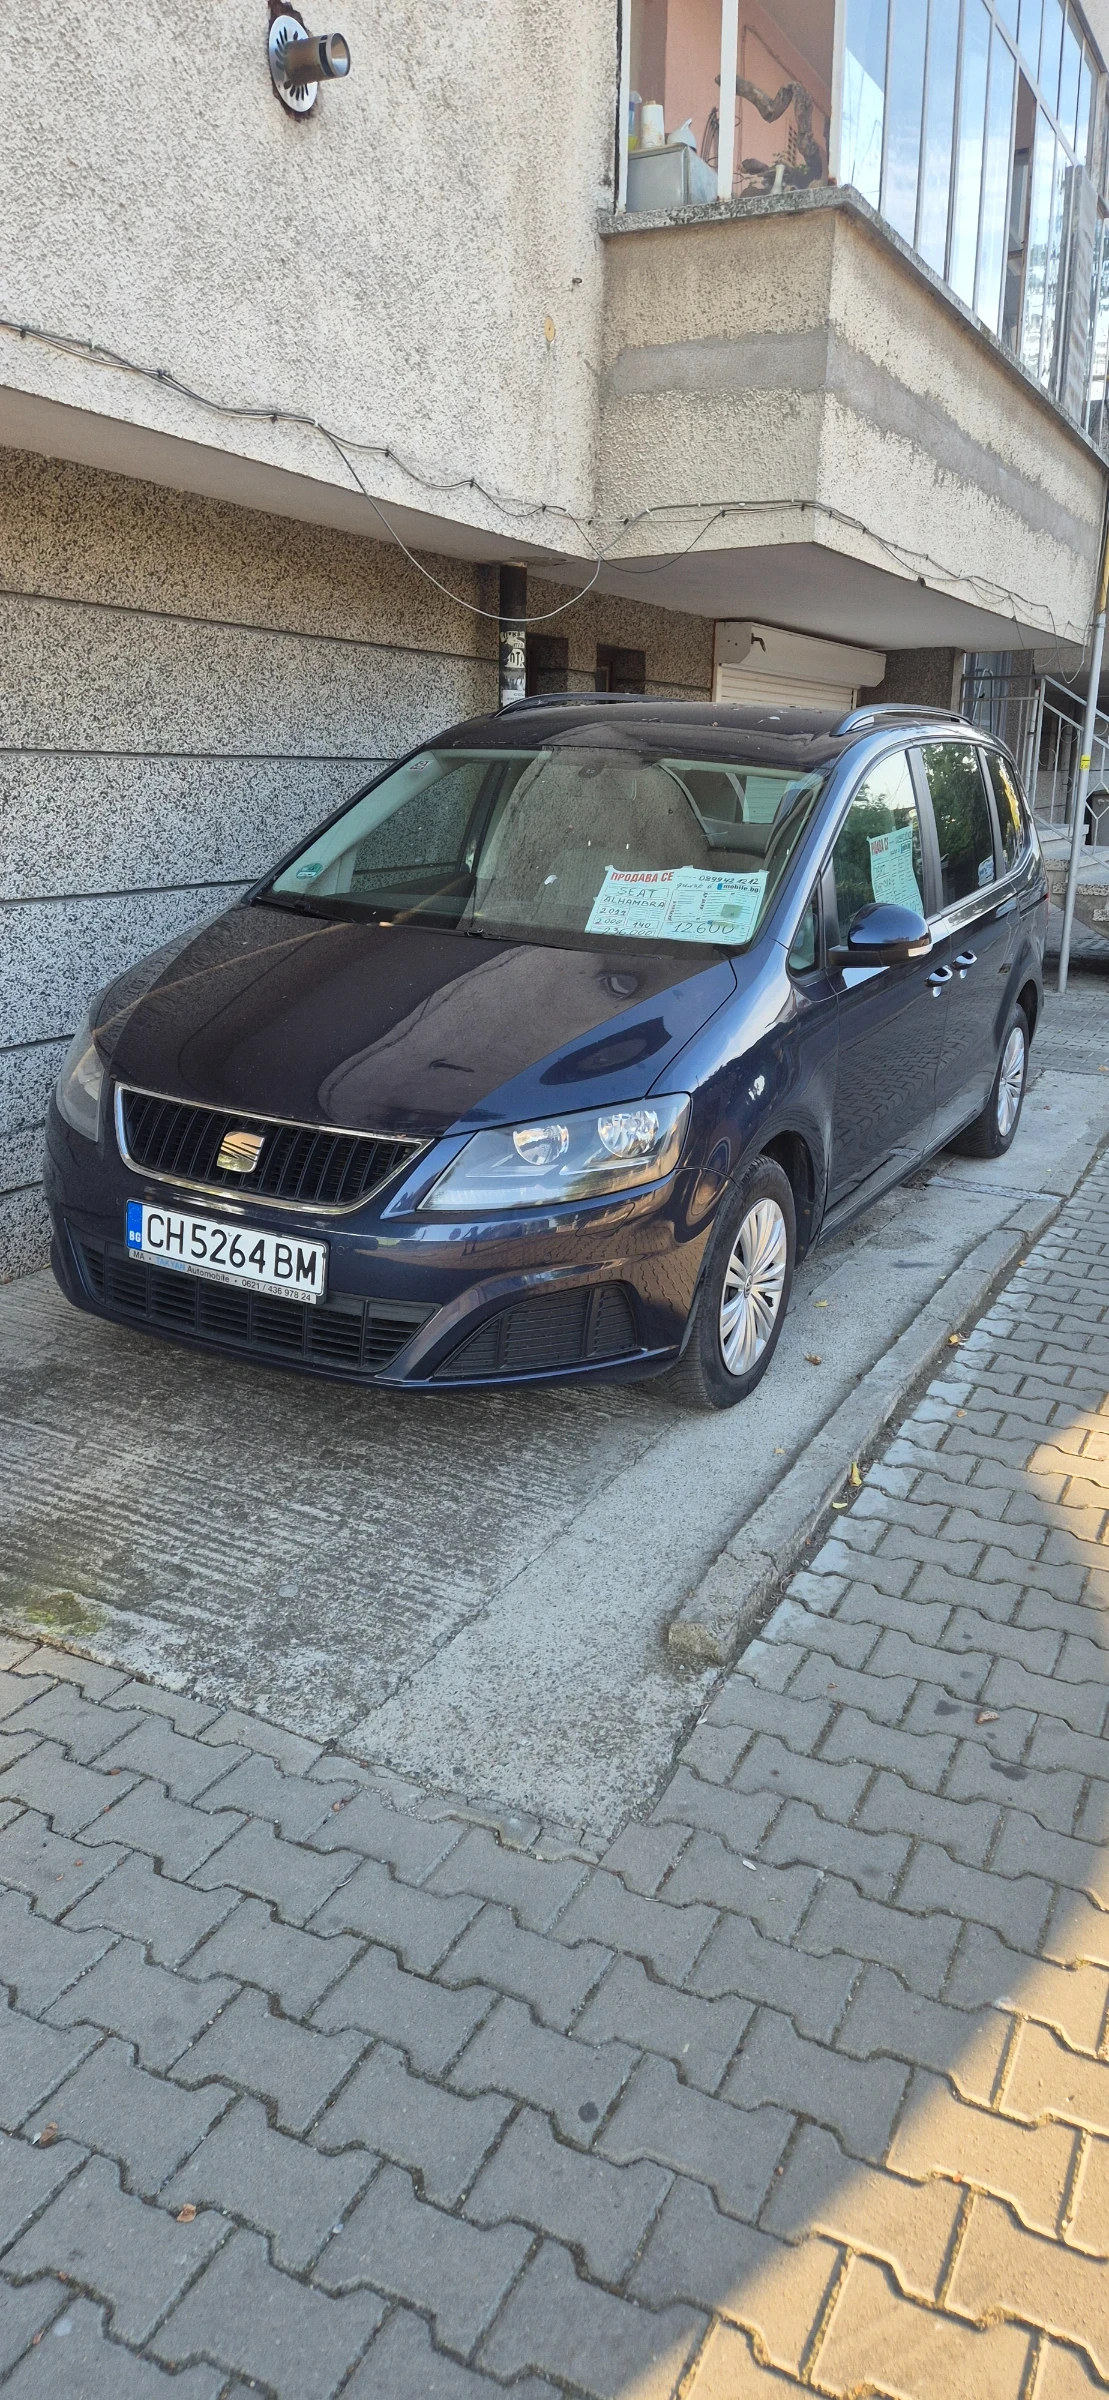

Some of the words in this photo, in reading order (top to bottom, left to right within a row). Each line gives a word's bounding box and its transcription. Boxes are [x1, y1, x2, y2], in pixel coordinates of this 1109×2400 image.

[610, 872, 659, 883] ПРОДАВА
[661, 871, 675, 882] СЕ
[617, 886, 658, 898] SEAT
[723, 883, 760, 893] mobile.bg
[604, 896, 666, 908] ALHAMBRA
[129, 1230, 142, 1243] BG
[133, 1250, 145, 1261] MA
[187, 1265, 230, 1283] Automobile
[241, 1279, 260, 1290] 0621
[284, 1288, 299, 1299] 978
[301, 1293, 311, 1302] 24
